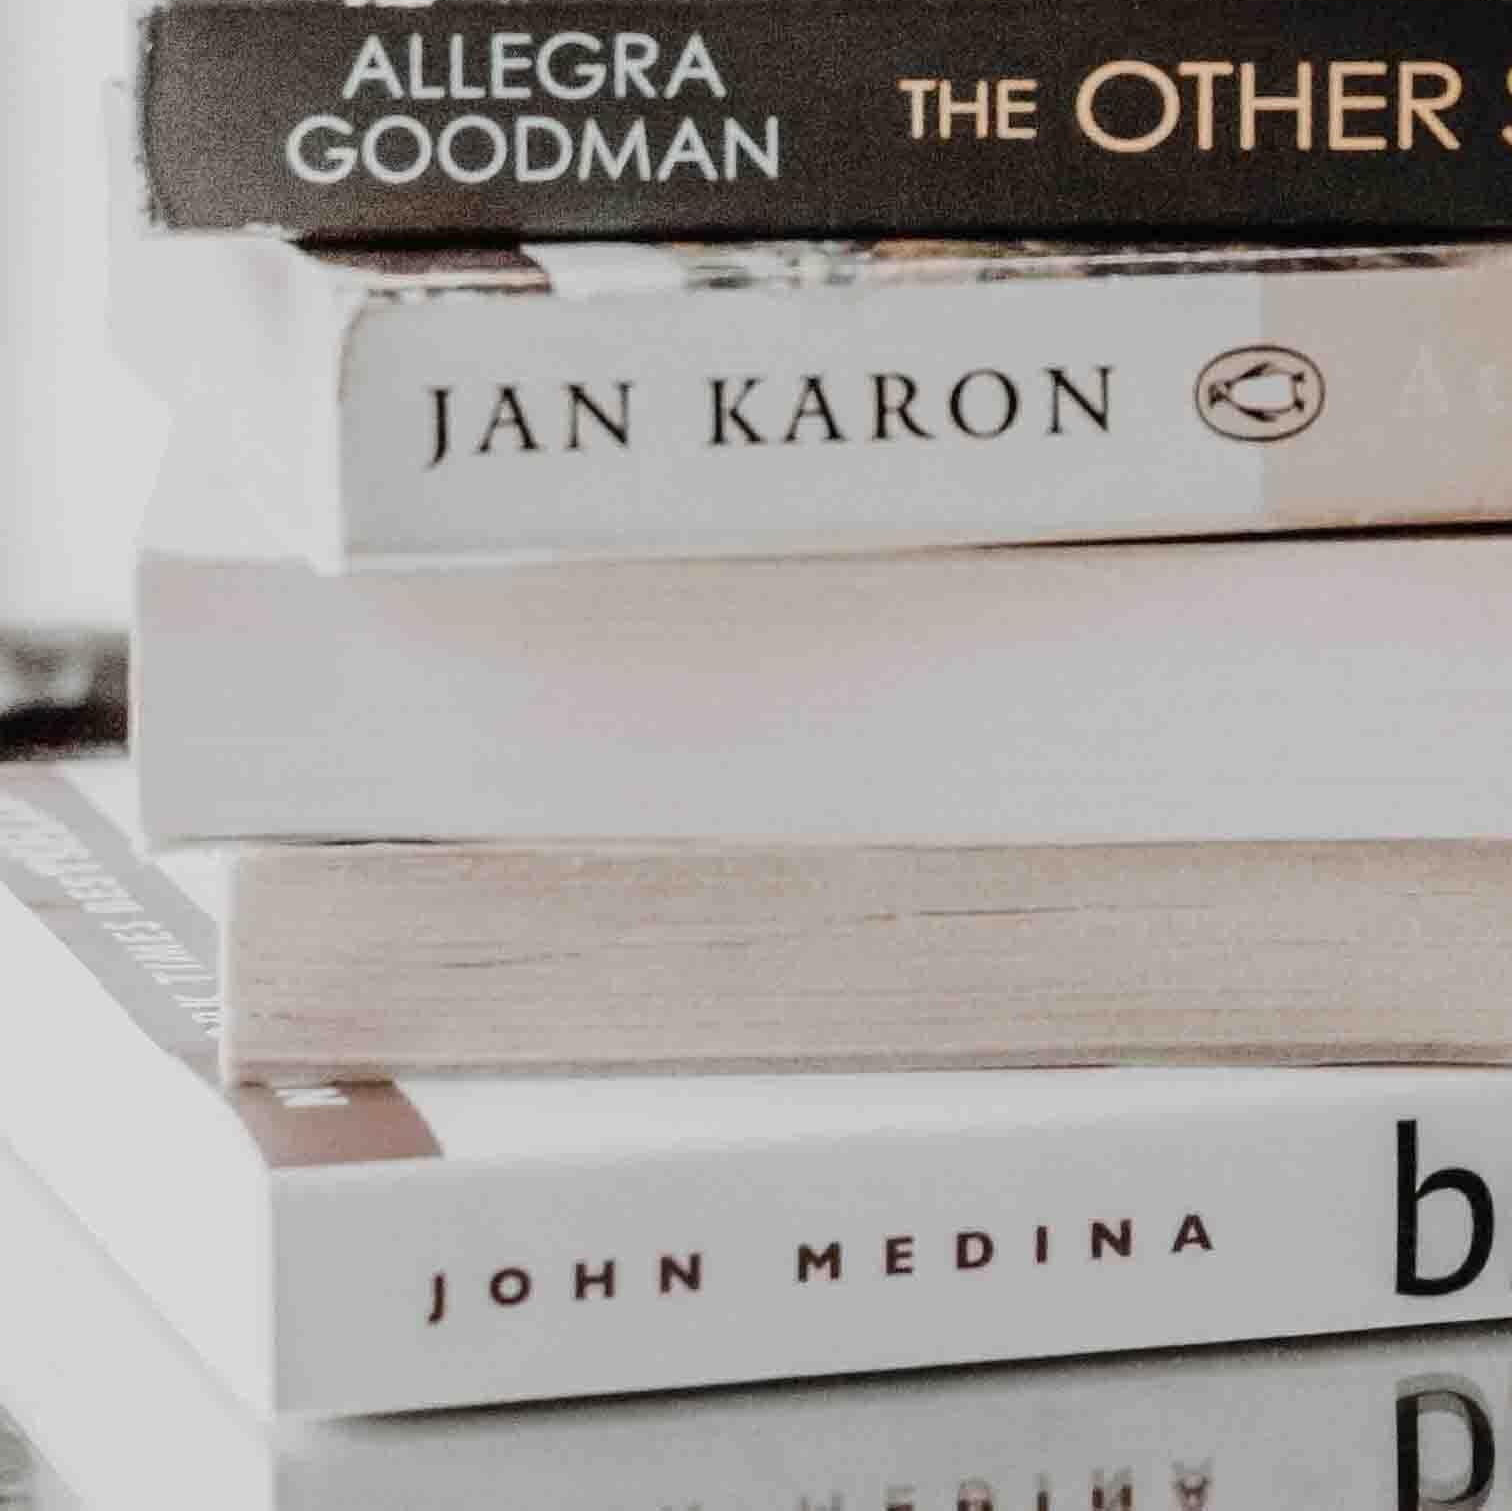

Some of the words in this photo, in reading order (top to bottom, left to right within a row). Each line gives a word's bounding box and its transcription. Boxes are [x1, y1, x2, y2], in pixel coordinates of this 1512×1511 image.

[341, 32, 727, 100] ALLEGRA
[898, 79, 1038, 140] THE
[1075, 60, 1462, 153] OTHER
[284, 115, 779, 183] GOODMAN
[430, 381, 636, 468] JAN
[708, 365, 1115, 447] KARON
[428, 1253, 701, 1325] JOHN
[797, 1214, 1214, 1283] MEDINA
